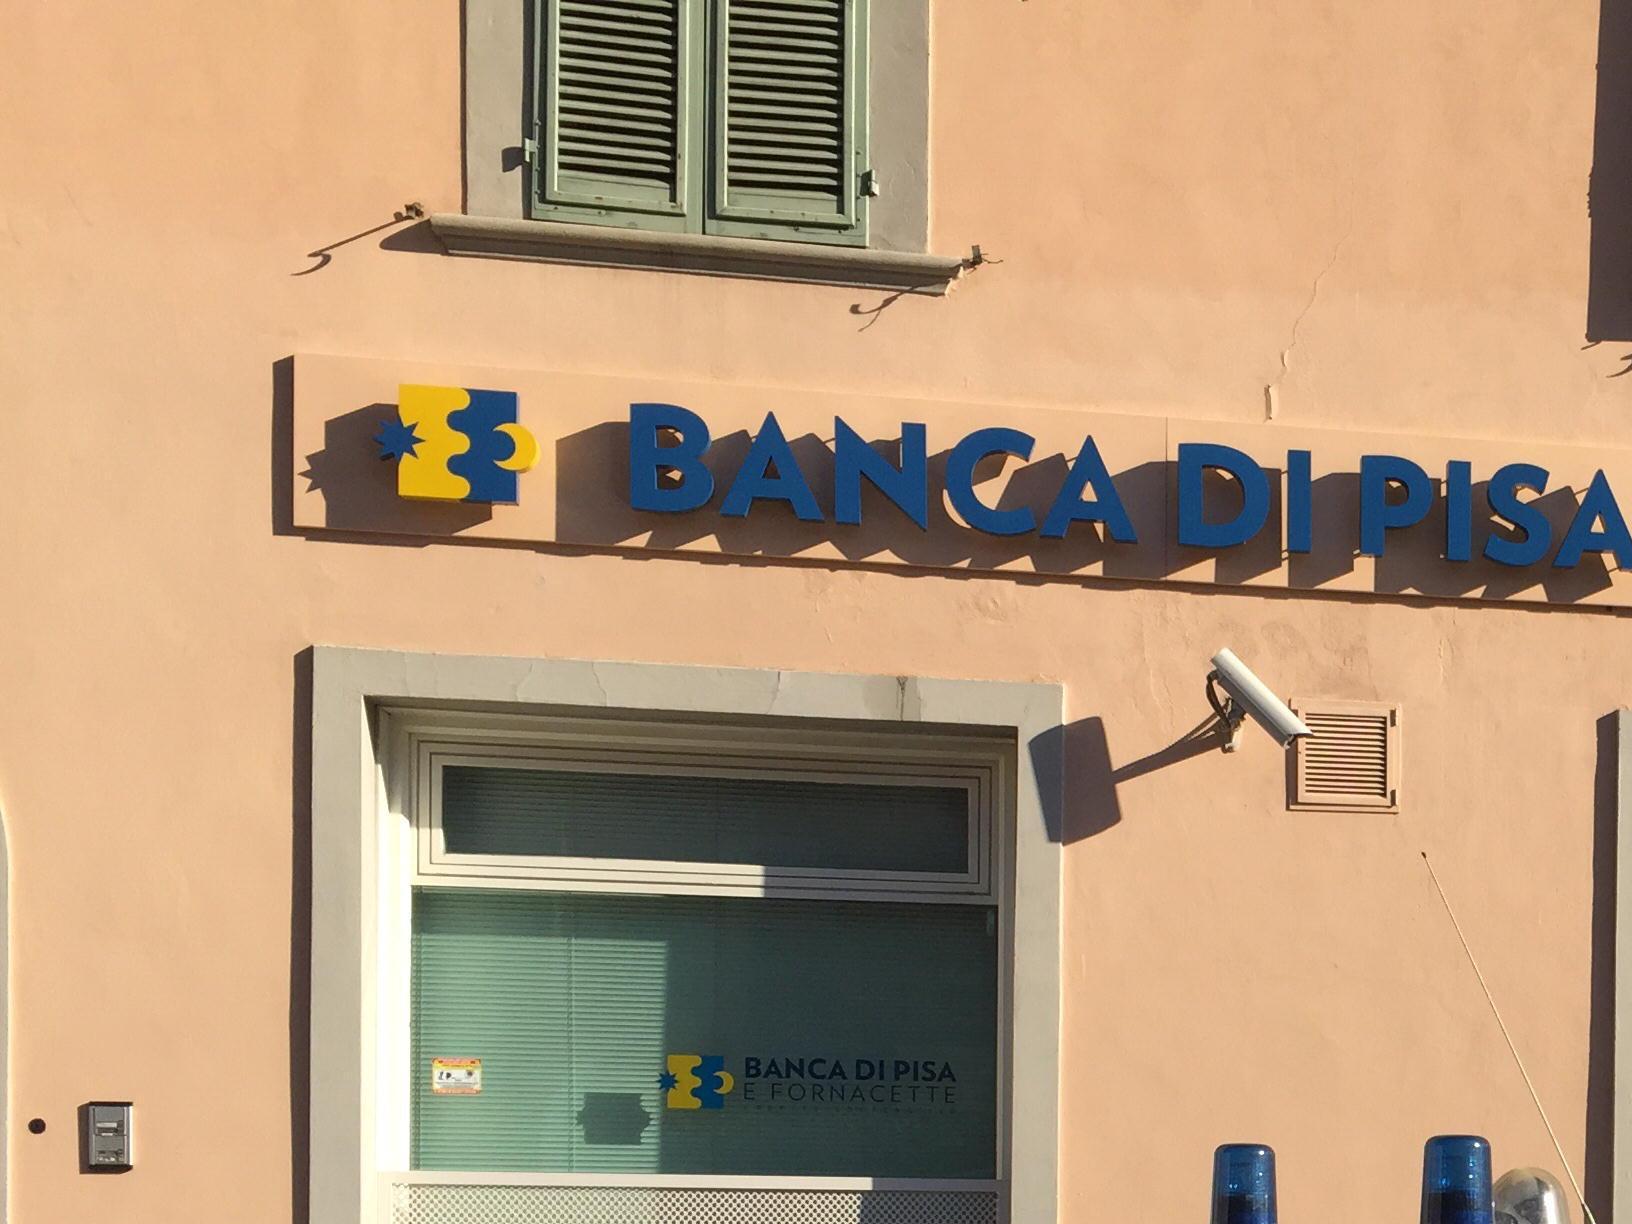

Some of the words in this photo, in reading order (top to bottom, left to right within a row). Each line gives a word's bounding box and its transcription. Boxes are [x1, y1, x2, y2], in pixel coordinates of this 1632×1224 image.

[629, 401, 1138, 544] BANCA
[1177, 442, 1312, 554] DI
[745, 1056, 848, 1080] BANCA
[855, 1058, 884, 1081] DI
[894, 1060, 957, 1083] PISA
[743, 1083, 756, 1100] E
[770, 1083, 956, 1104] FORNACETTE
